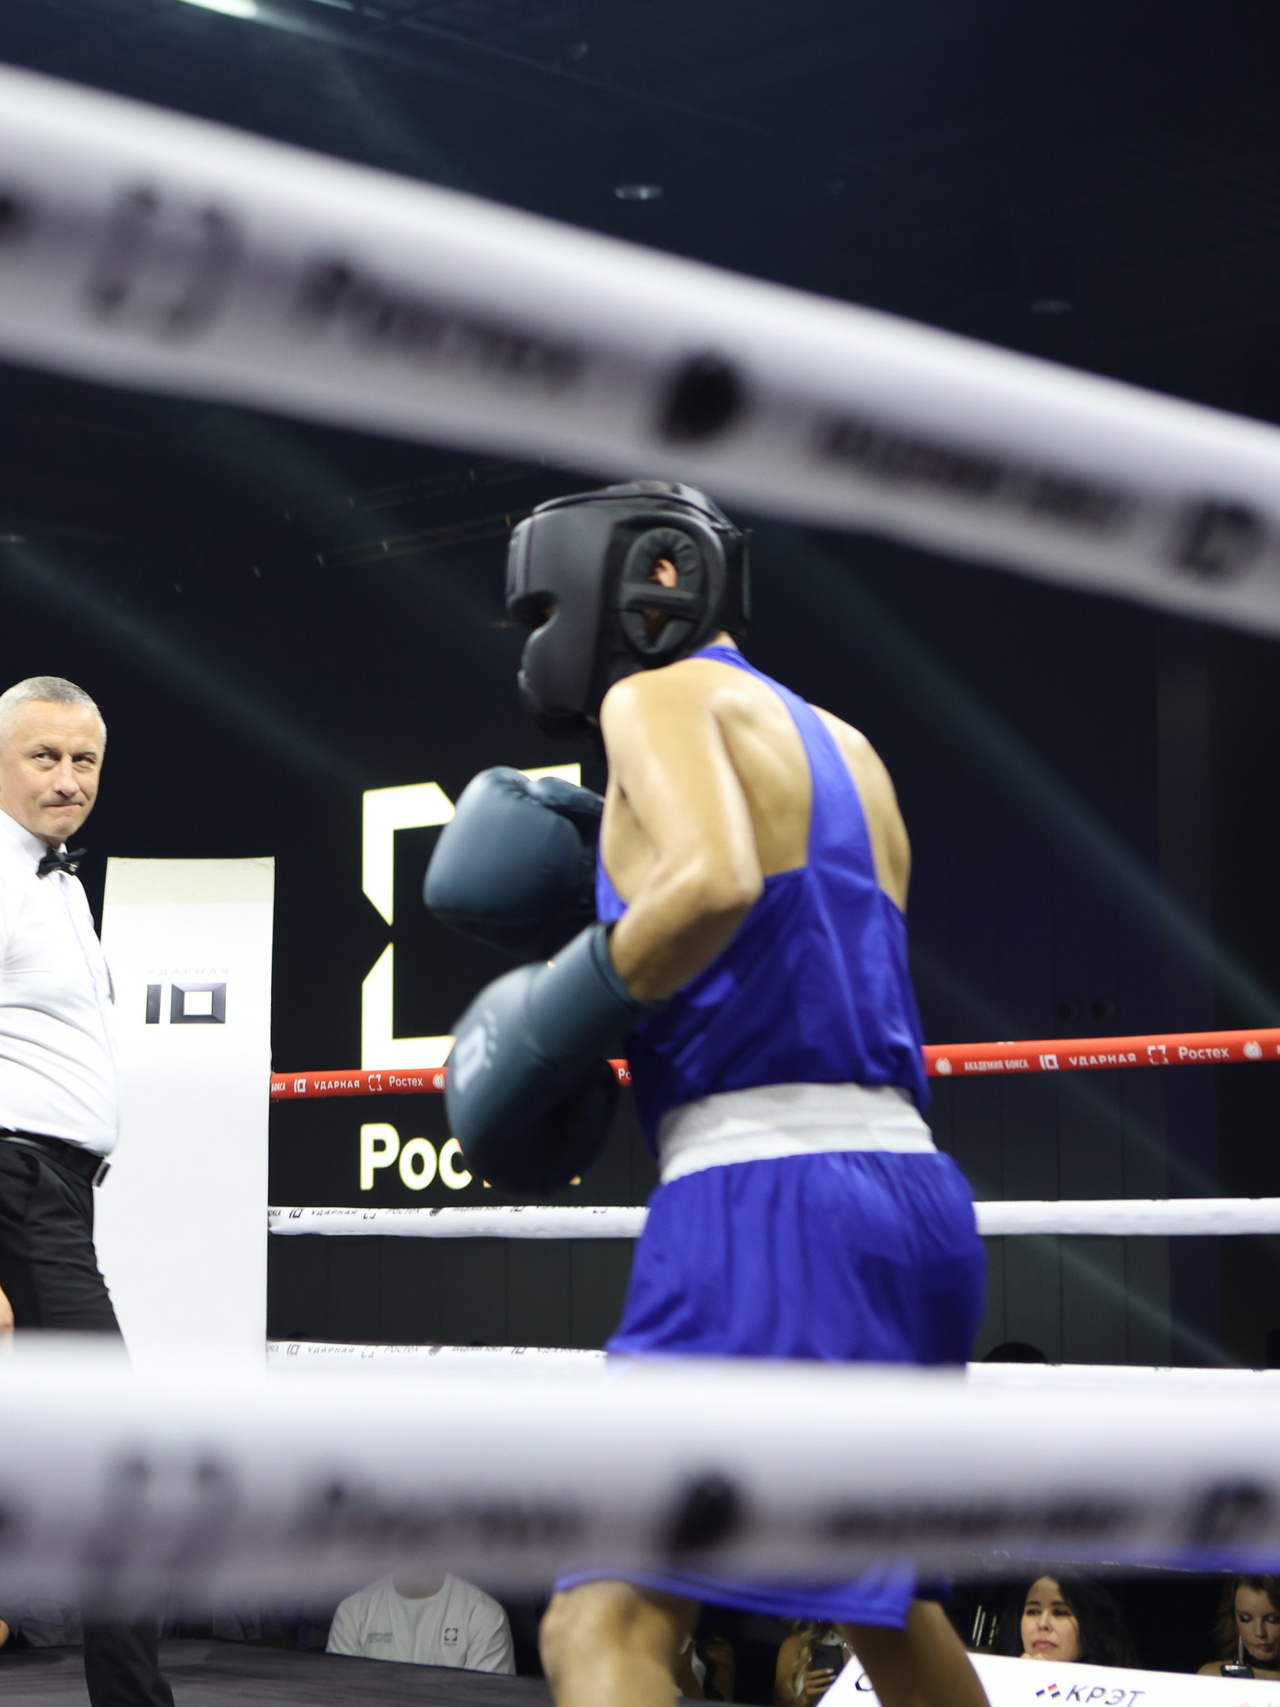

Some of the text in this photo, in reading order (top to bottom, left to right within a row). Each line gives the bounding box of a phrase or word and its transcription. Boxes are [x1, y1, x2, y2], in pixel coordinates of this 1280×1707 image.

[964, 1059, 1003, 1071] АКАДЕМИЯ
[1005, 1058, 1029, 1069] БОКСА
[1069, 1053, 1137, 1067] УДАРНАЯ
[1178, 1046, 1230, 1059] Ростех
[313, 1079, 360, 1090] УДАРНАЯ
[388, 1075, 423, 1087] Ростех
[1065, 1683, 1147, 1707] КРЭТ
